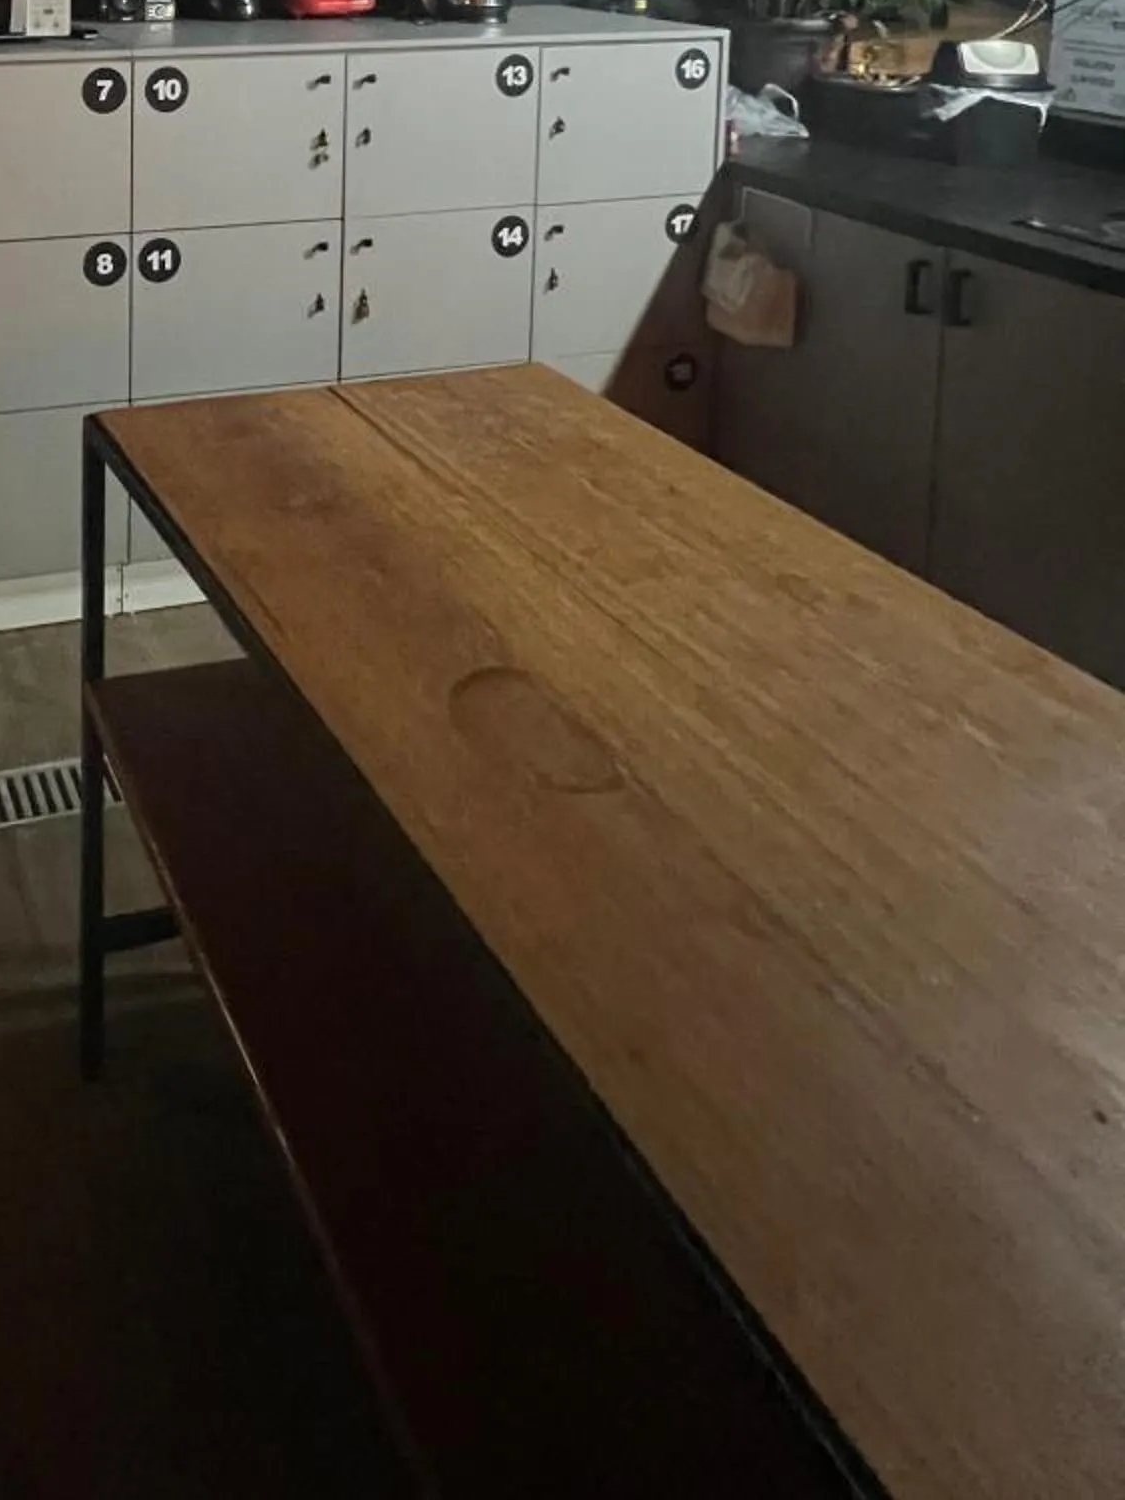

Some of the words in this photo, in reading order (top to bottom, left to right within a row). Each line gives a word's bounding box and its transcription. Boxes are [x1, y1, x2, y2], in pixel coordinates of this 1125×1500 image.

[502, 65, 528, 87] 13
[680, 58, 705, 79] 16
[96, 80, 114, 101] 7
[152, 79, 181, 101] 10
[670, 213, 695, 234] 17
[497, 226, 524, 247] 14
[96, 253, 114, 275] 8
[146, 249, 172, 271] 11
